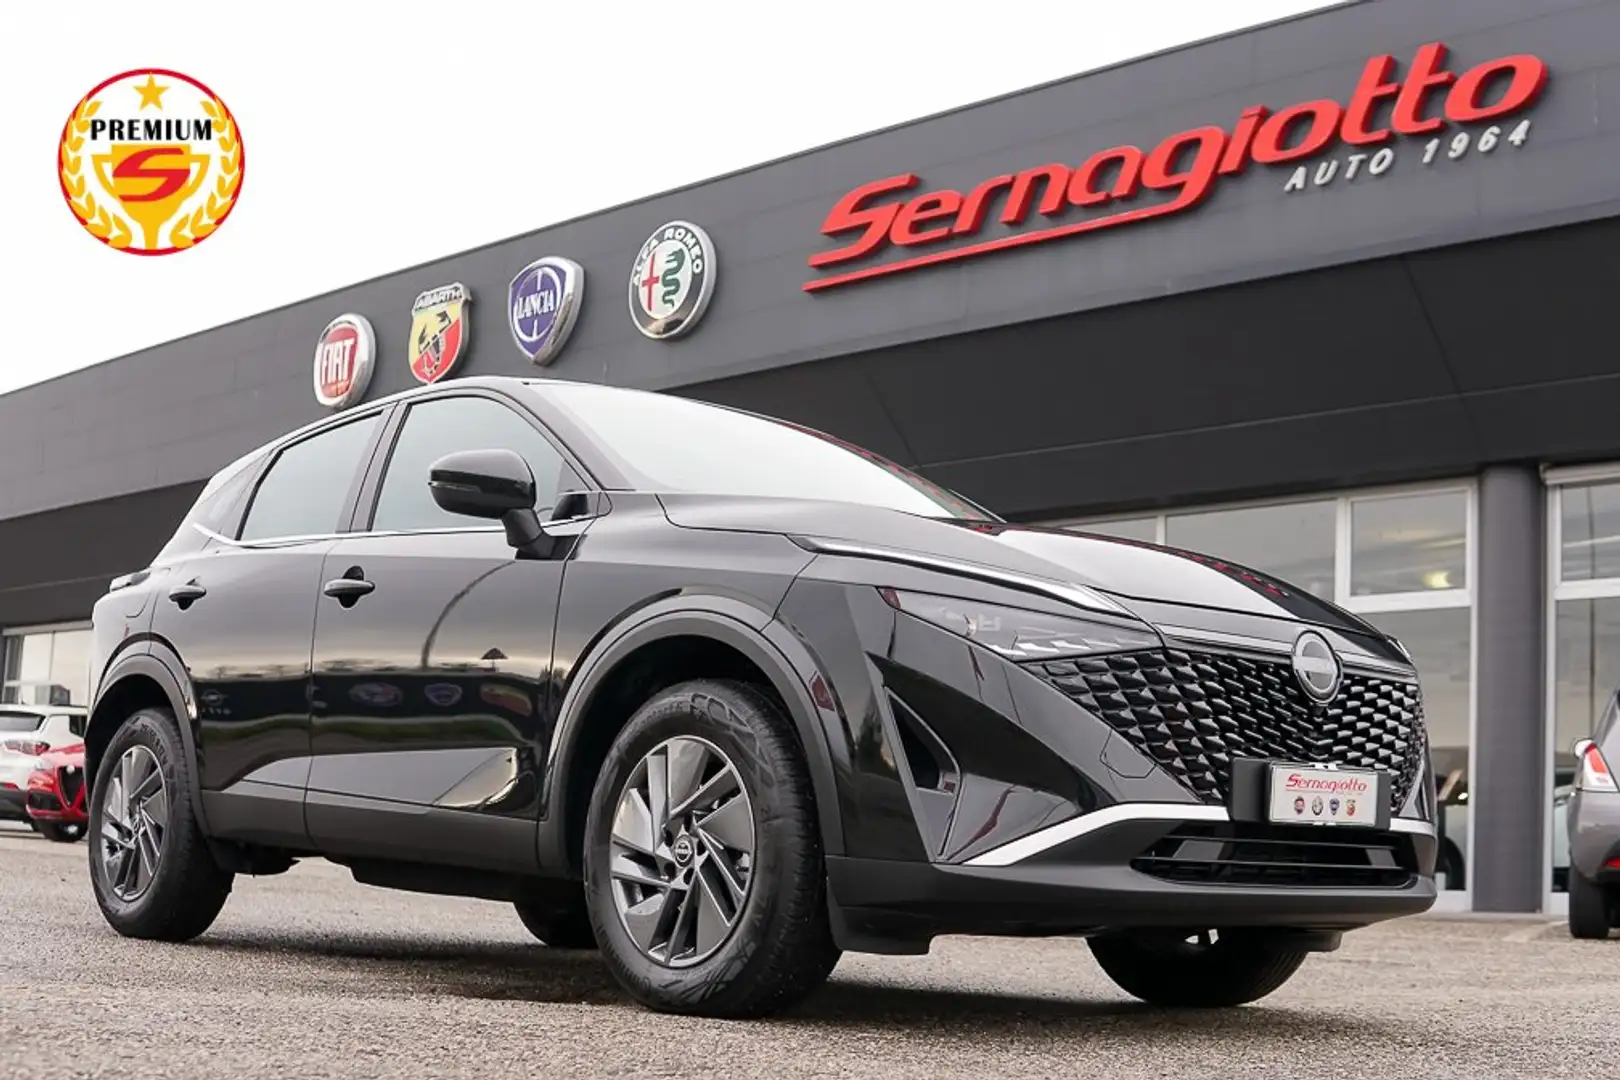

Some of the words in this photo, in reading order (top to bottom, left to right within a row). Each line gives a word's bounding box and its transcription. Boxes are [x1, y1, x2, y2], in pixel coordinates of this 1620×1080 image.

[803, 42, 1548, 292] Sernagiotto
[1284, 148, 1395, 192] AUTO
[1422, 119, 1531, 164] 1964
[663, 228, 704, 274] ROMEO
[516, 290, 555, 319] LANCIA
[321, 338, 355, 385] FIAT
